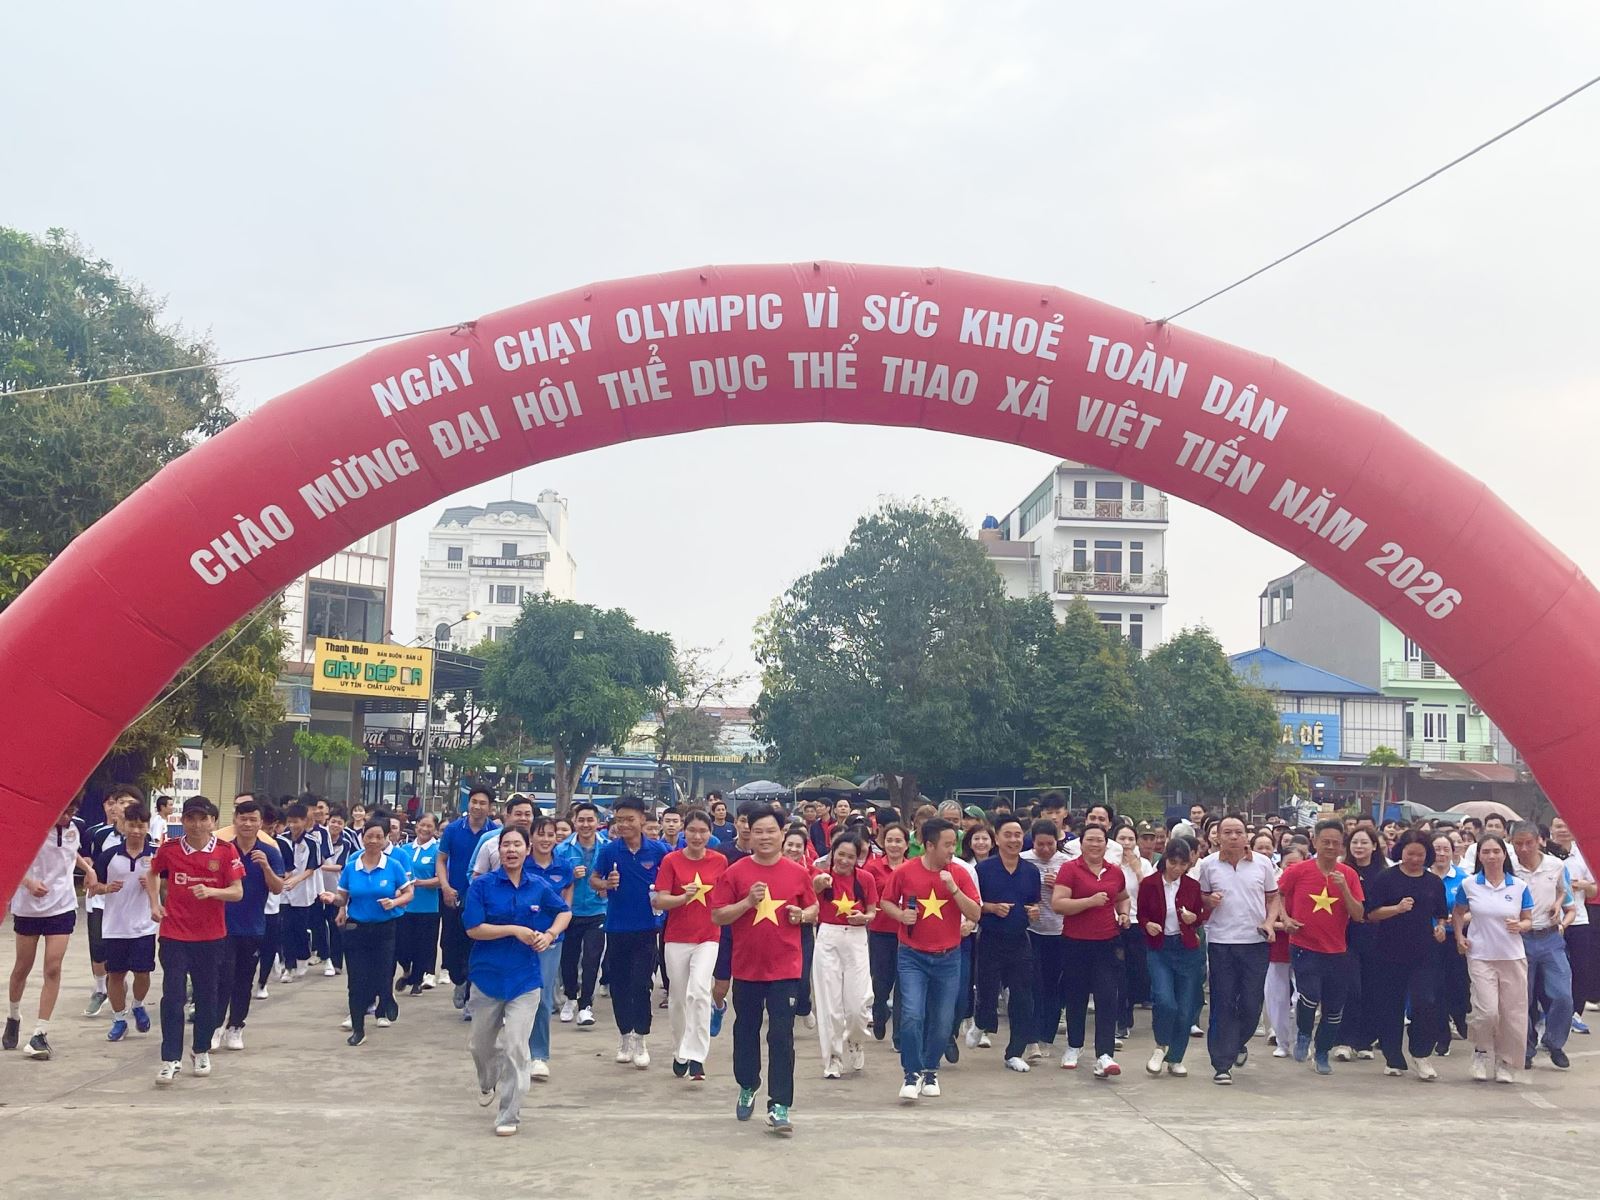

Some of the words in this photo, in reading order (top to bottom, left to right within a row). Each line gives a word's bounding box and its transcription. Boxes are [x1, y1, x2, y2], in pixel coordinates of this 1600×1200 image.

[370, 347, 474, 418] NGÀY
[493, 314, 593, 372] CHẠY
[615, 292, 784, 345] OLYMPIC
[802, 285, 840, 329] VÌ
[861, 292, 940, 338] SỨC
[959, 306, 1065, 362] KHOẺ
[1086, 334, 1189, 399] TOÀN
[1200, 374, 1289, 442] DÂN
[189, 504, 295, 586] CHÀO
[298, 438, 420, 520] MỪNG
[428, 404, 501, 460] ĐẠI
[511, 377, 583, 431] HỘI
[597, 343, 673, 411] THỂ
[689, 354, 768, 400] DỤC
[787, 332, 860, 390] THỂ
[881, 355, 979, 406] THAO
[997, 375, 1054, 422] XÃ
[1075, 395, 1162, 449] VIỆT
[1175, 430, 1266, 495] TIẾN
[1268, 478, 1368, 552] NĂM
[1364, 541, 1463, 620] 2026
[325, 641, 350, 653] Thanh
